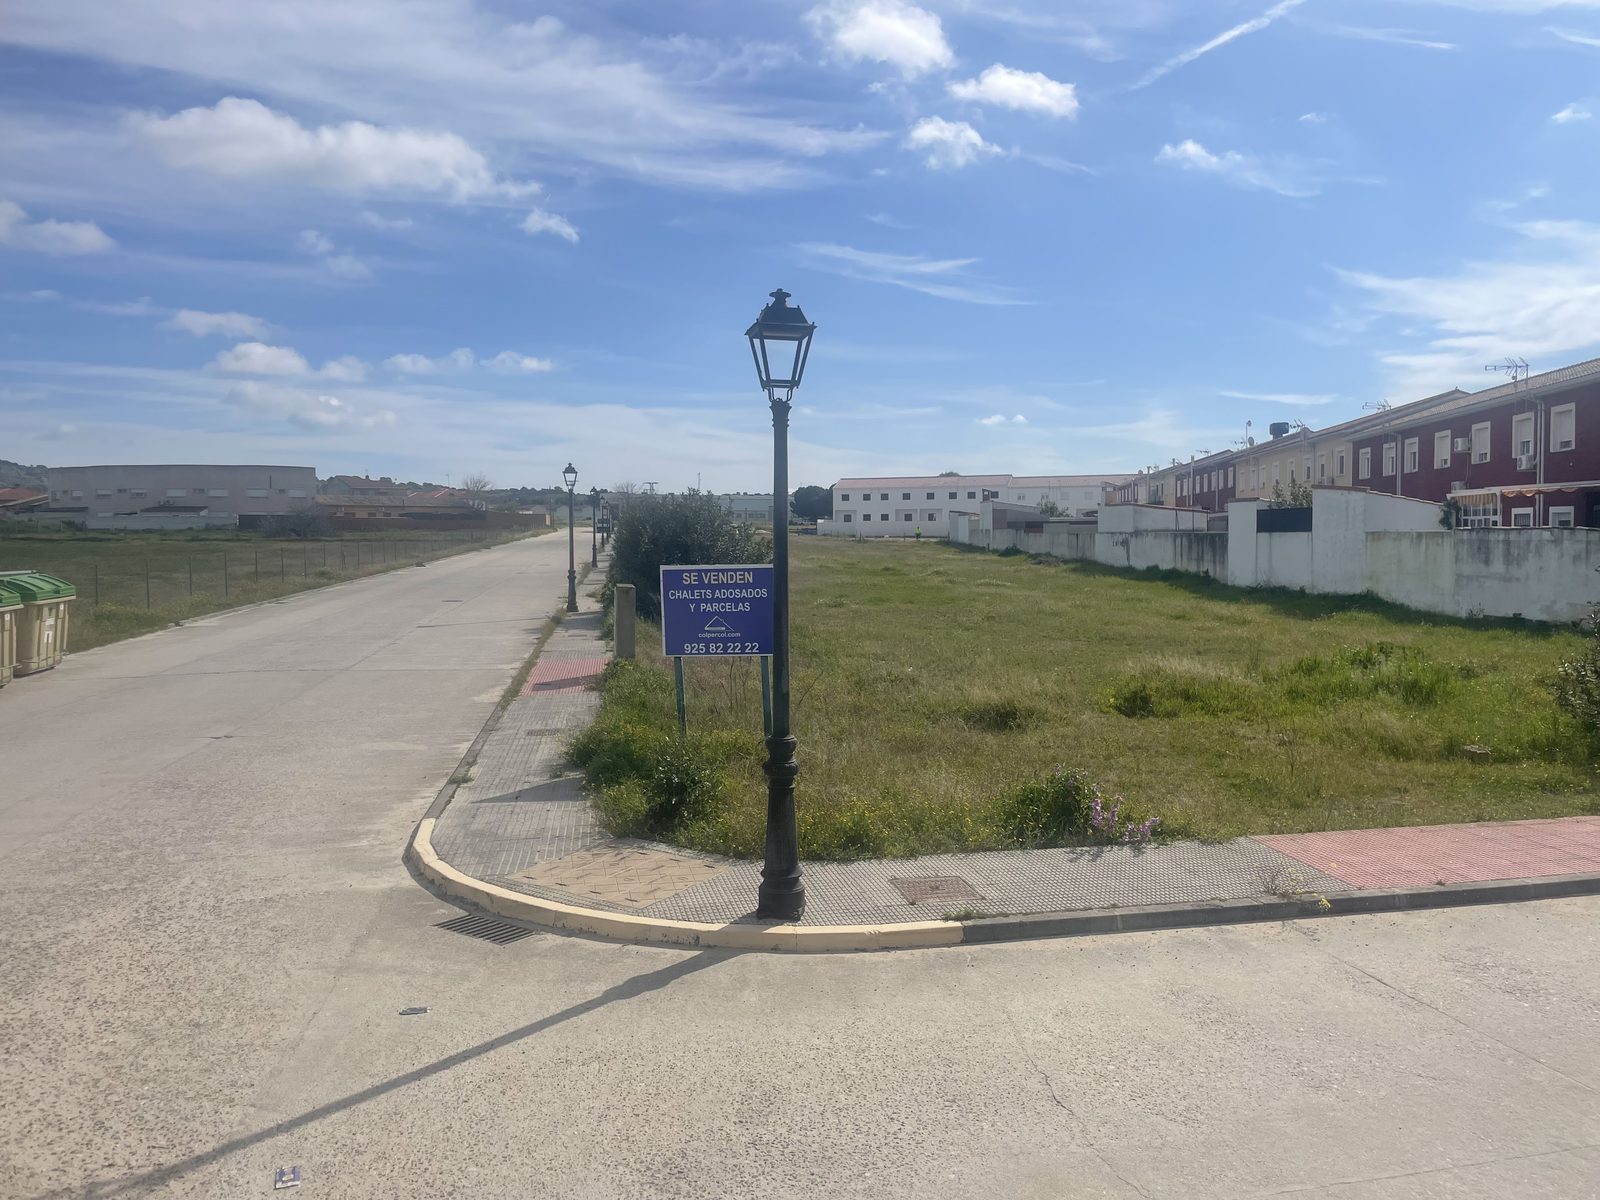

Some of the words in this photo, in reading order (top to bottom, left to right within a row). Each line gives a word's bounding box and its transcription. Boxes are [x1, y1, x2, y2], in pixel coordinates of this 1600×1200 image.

[682, 572, 699, 585] SE
[702, 571, 753, 584] VENDEN
[668, 589, 712, 600] CHALETS
[714, 588, 768, 599] ADOSADOS
[689, 603, 696, 612] Y
[700, 603, 750, 612] PARCELAS
[684, 643, 706, 653] 925
[709, 643, 724, 653] 82
[727, 642, 741, 653] 22
[744, 642, 759, 653] 22
